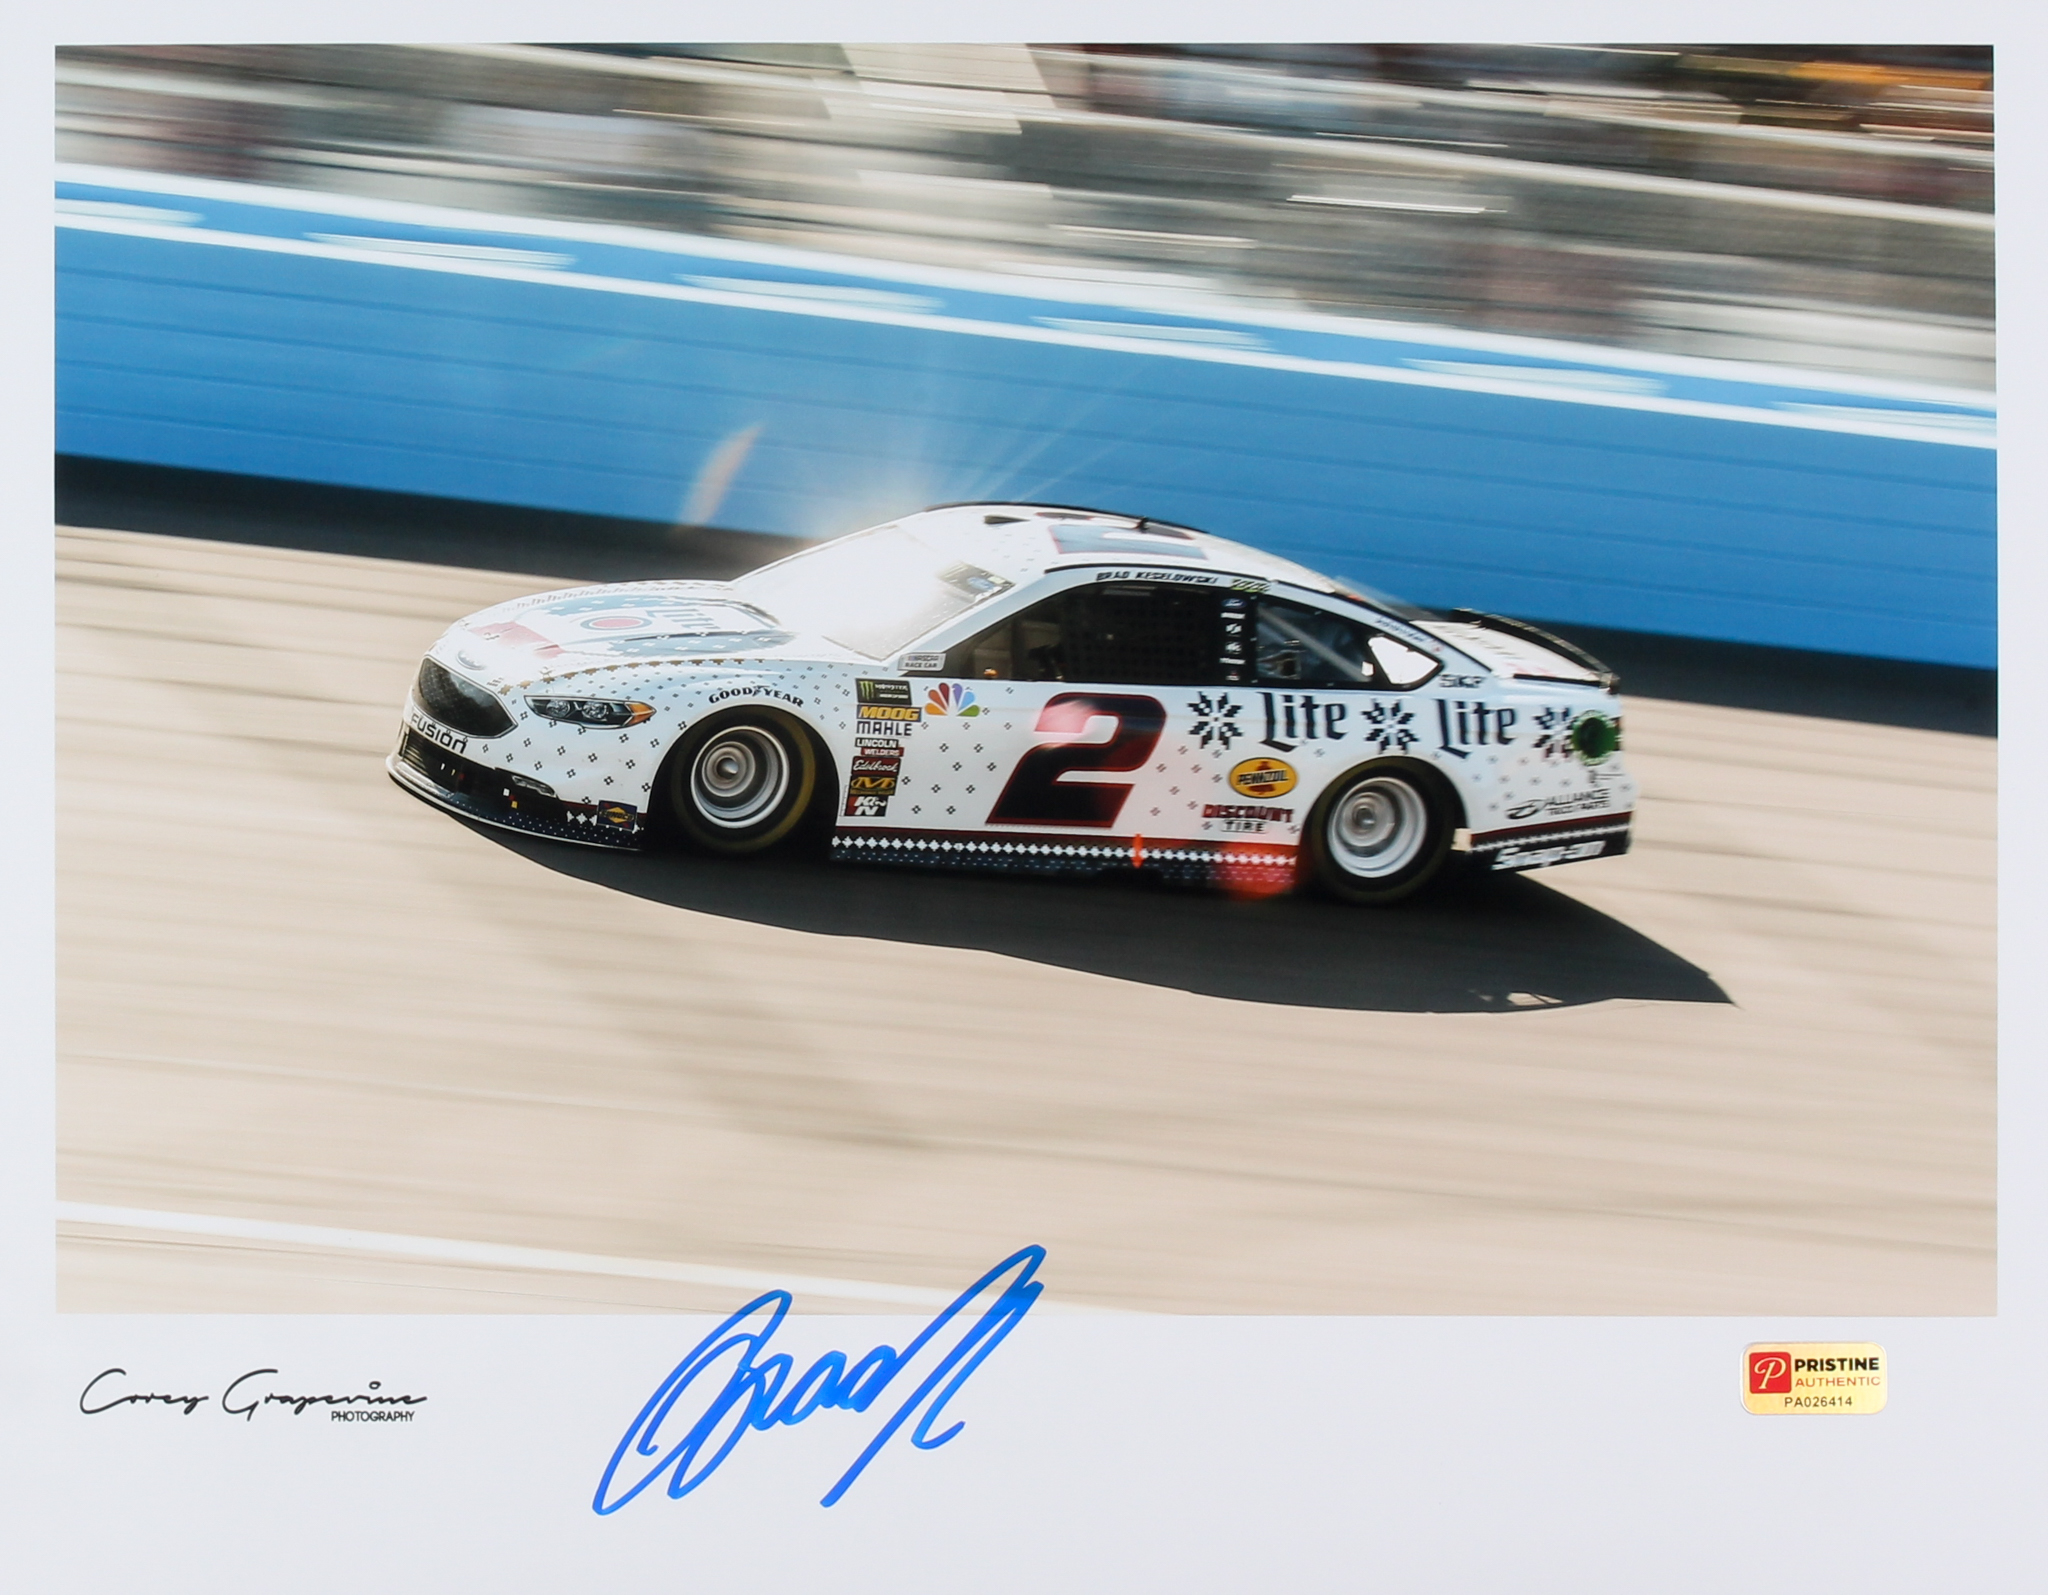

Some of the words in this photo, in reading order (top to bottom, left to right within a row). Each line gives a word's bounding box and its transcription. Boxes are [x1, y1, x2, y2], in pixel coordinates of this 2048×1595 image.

[1096, 571, 1129, 581] BRAD
[1135, 571, 1218, 584] KESELOWSKI
[1440, 674, 1485, 688] SKF
[708, 685, 805, 708] GOODYEAR
[858, 706, 920, 721] MOOG
[856, 720, 912, 736] MAHLE
[1257, 692, 1348, 753] Lite
[1433, 698, 1518, 759] Lite
[856, 739, 897, 748] LINCOLN
[863, 748, 900, 756] WELDERS
[853, 760, 899, 772] Edelbrock
[985, 692, 1167, 828] 2
[1547, 788, 1611, 805] ALLIANCE
[1202, 804, 1294, 823] DISCOUNT
[1225, 821, 1264, 832] TIRE
[1794, 1357, 1880, 1372] PRISTINE
[1795, 1376, 1881, 1388] AUTHENTIC
[80, 1368, 209, 1415] Corey
[222, 1368, 427, 1422] Grapevine
[1784, 1396, 1853, 1408] PA026414
[331, 1410, 415, 1422] PHOTOGRAPHY
